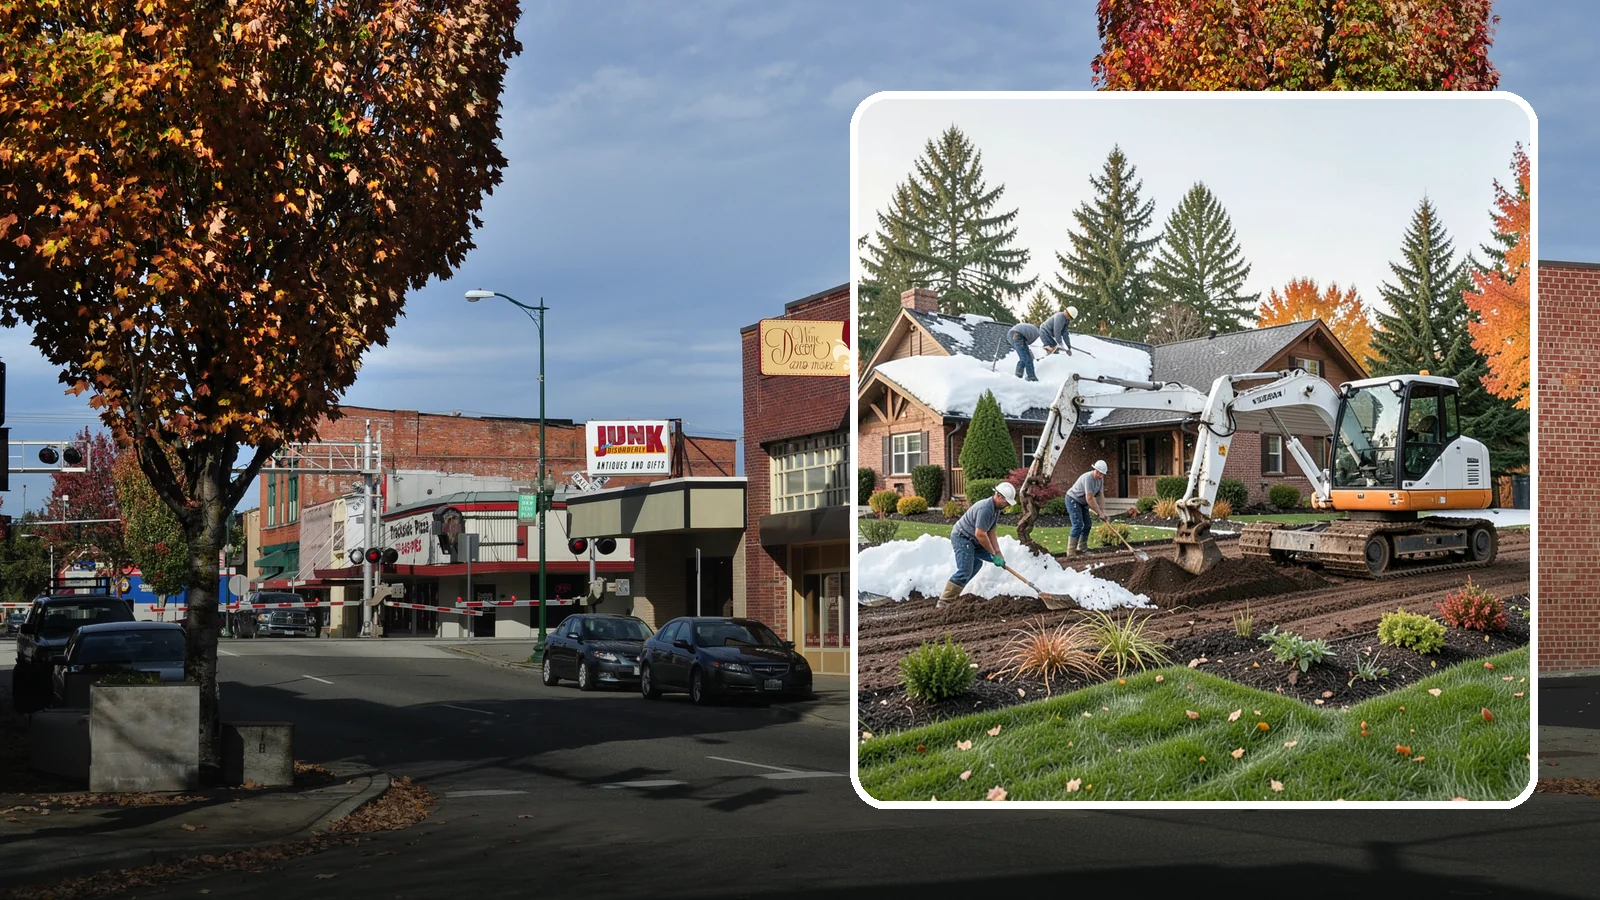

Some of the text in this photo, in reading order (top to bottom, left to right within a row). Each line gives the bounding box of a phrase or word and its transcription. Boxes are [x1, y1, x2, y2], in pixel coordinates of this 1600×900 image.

[595, 425, 665, 457] JUNK
[607, 446, 646, 454] DISORDERLY
[597, 461, 665, 470] ANTIQUES AND GIFTS
[390, 519, 429, 539] Trackside Pizza
